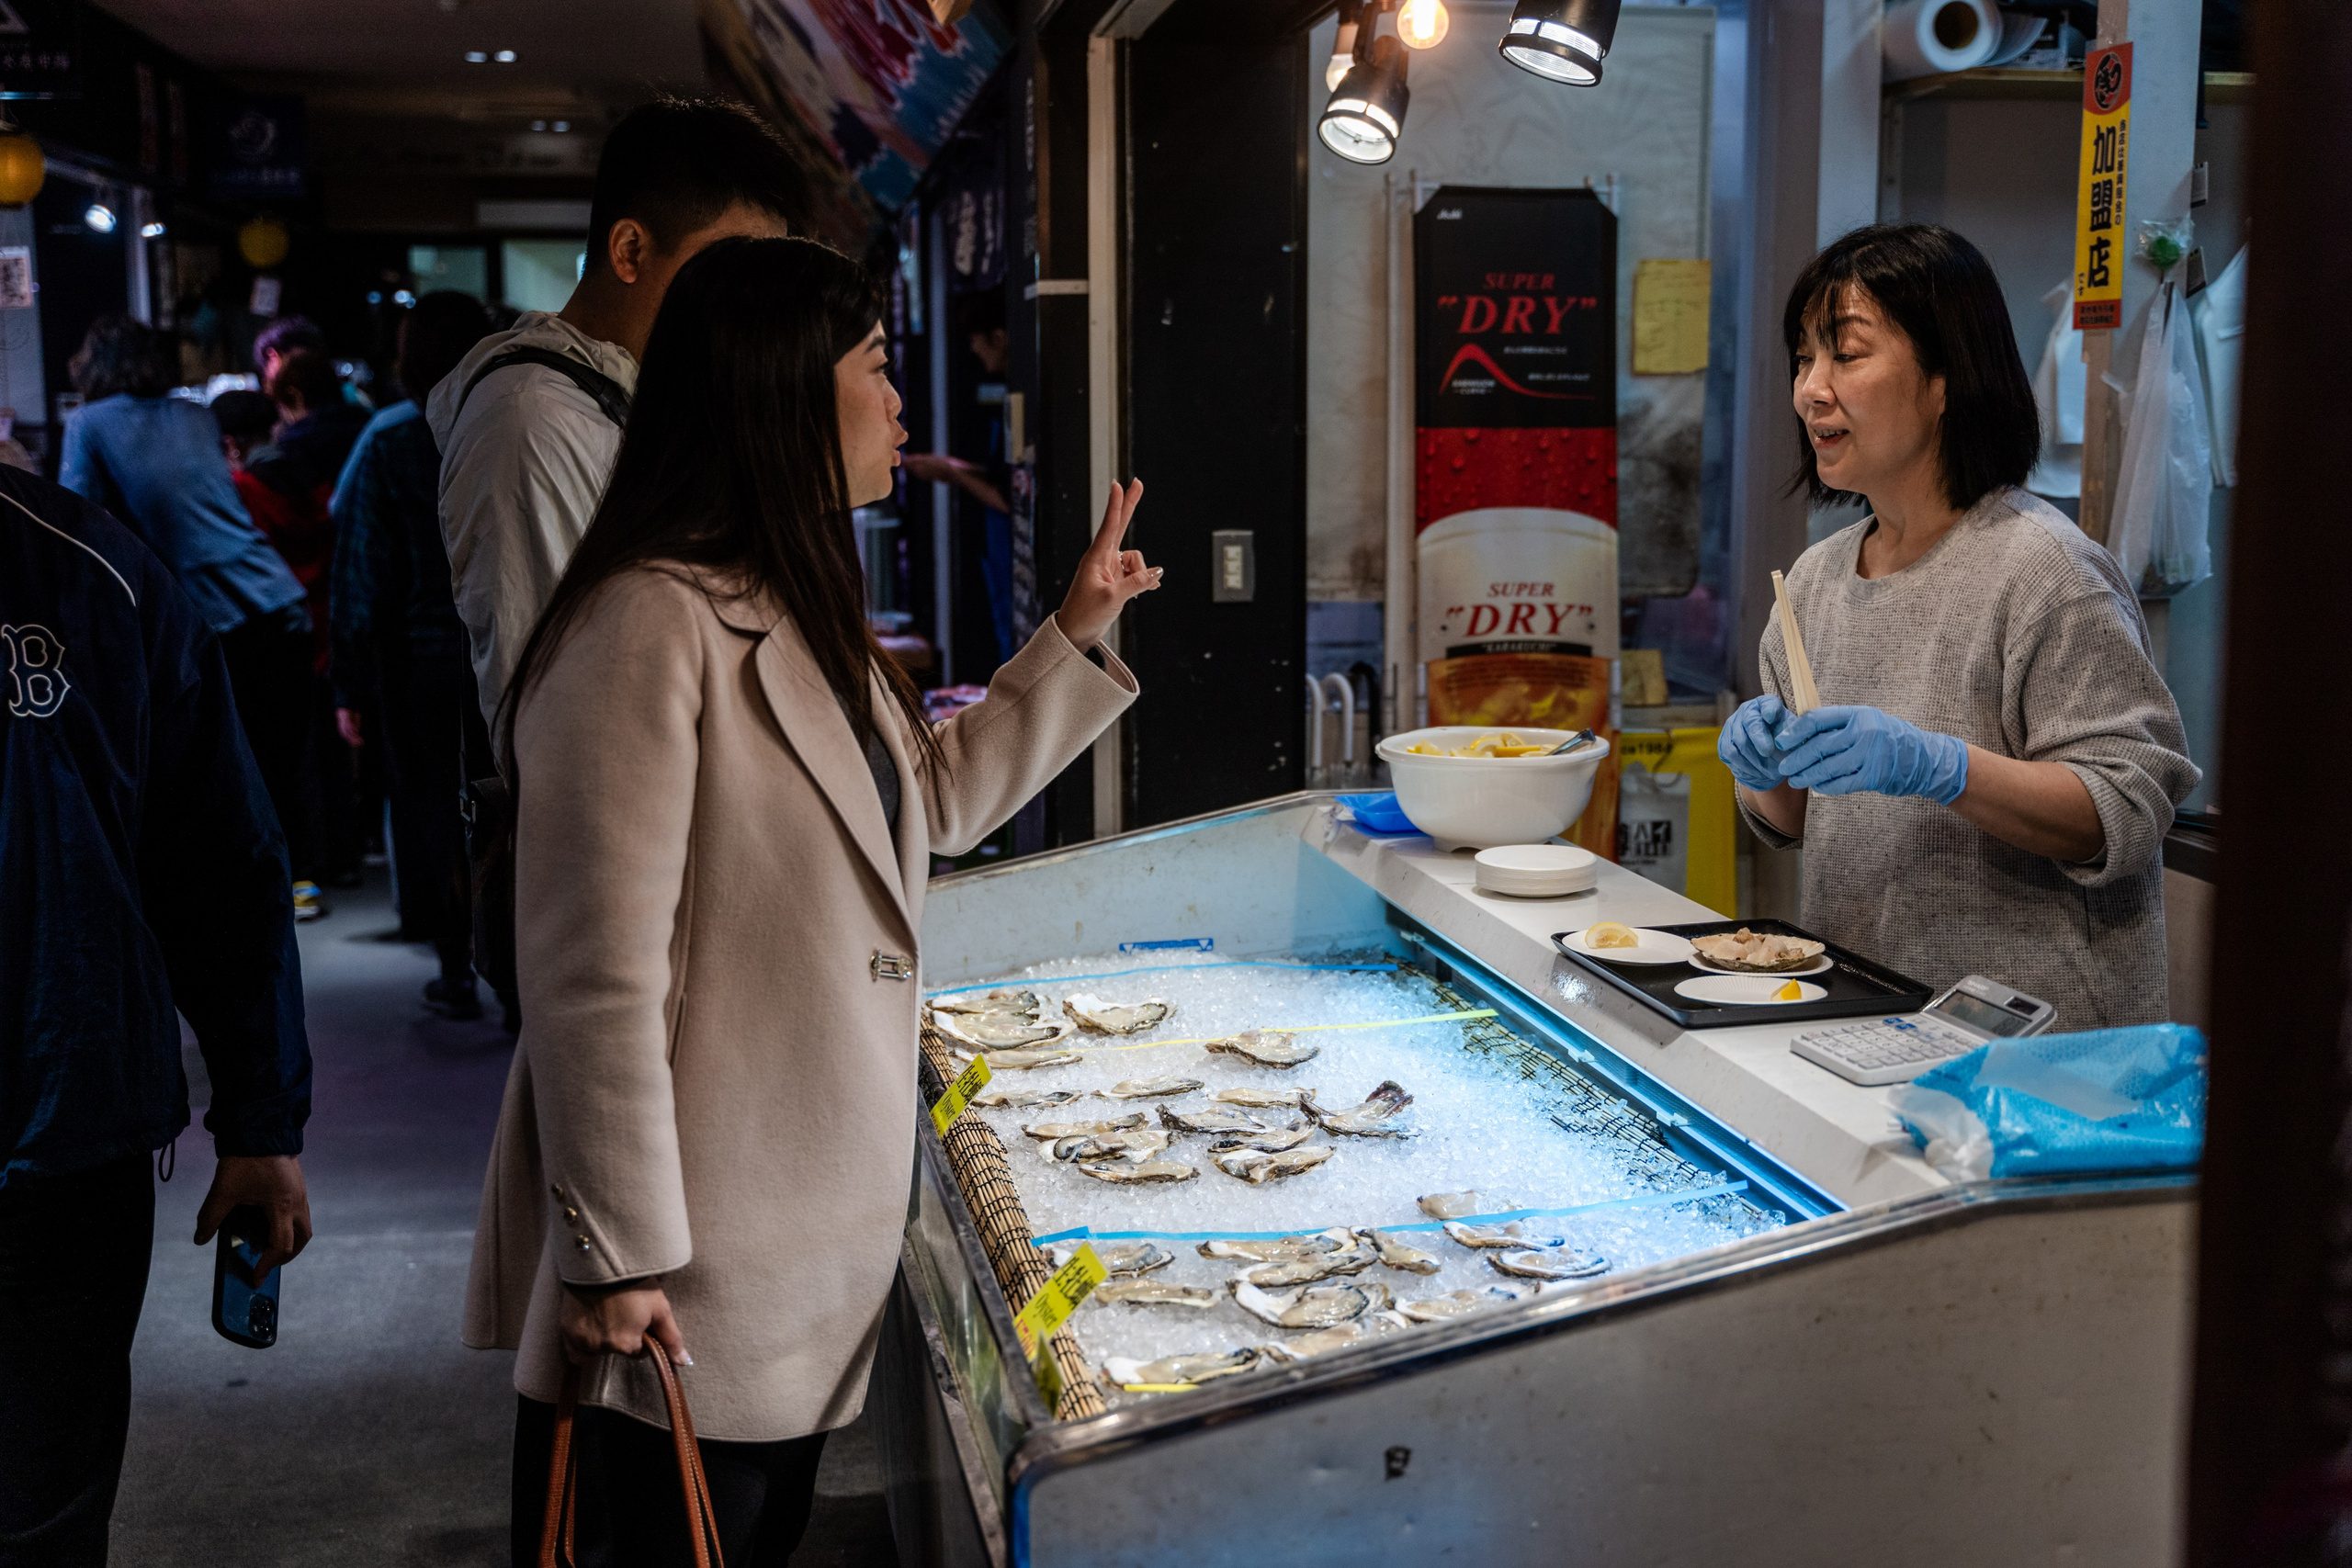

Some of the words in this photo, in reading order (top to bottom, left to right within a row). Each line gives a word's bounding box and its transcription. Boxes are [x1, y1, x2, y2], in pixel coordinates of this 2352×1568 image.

[2086, 124, 2117, 288] 加盟店
[1484, 273, 1555, 290] SUPER
[1487, 582, 1555, 597] SUPER
[1, 624, 71, 717] B
[940, 1093, 956, 1120] Oyster
[1033, 1292, 1057, 1328] Oyster
